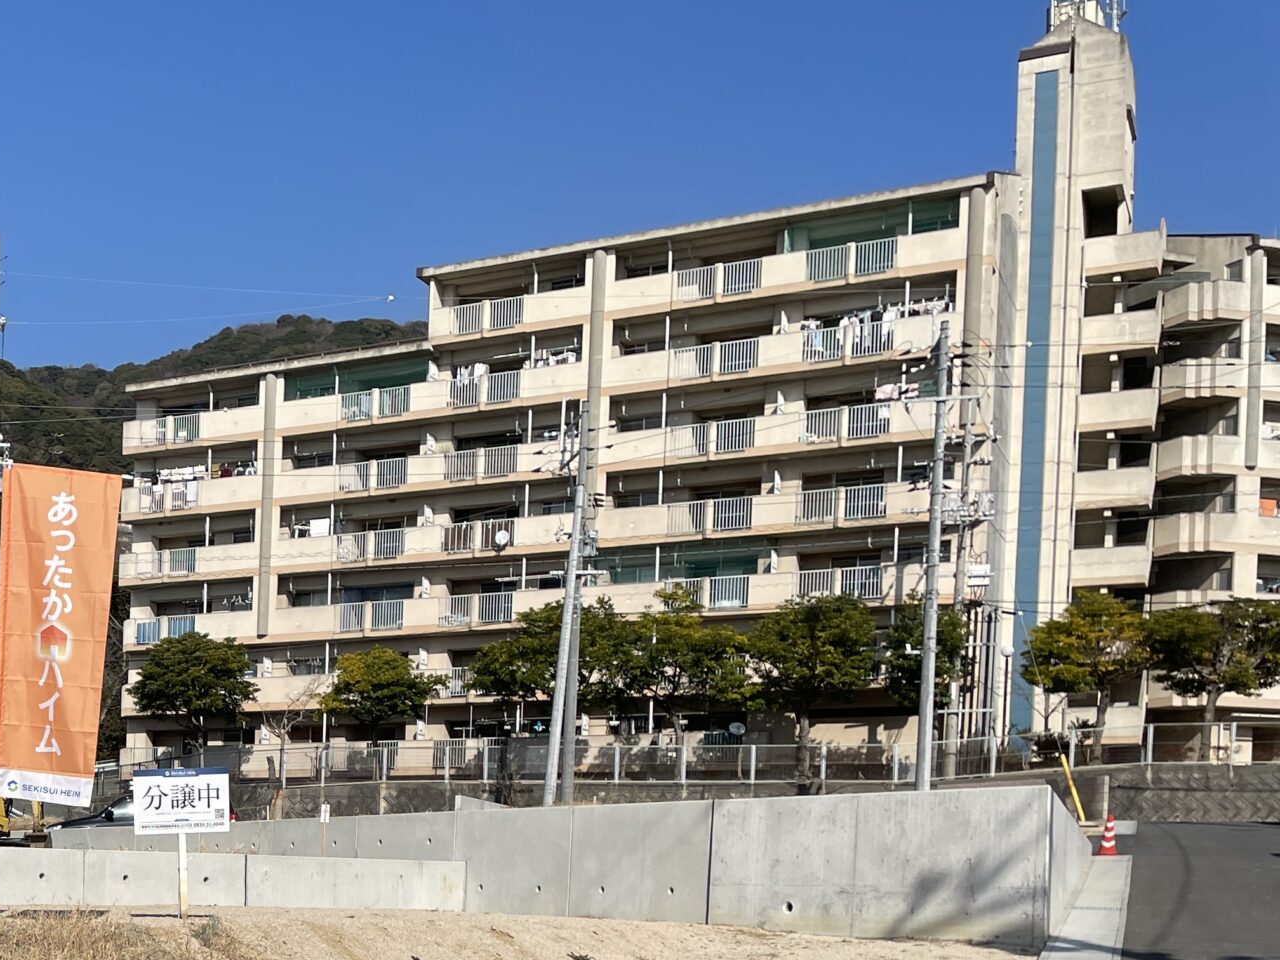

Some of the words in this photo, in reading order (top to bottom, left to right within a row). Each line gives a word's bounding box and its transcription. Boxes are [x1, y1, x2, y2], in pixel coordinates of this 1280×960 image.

[21, 783, 59, 795] SEKISUI
[60, 789, 81, 798] HEIM
[142, 783, 220, 811] 分譲中
